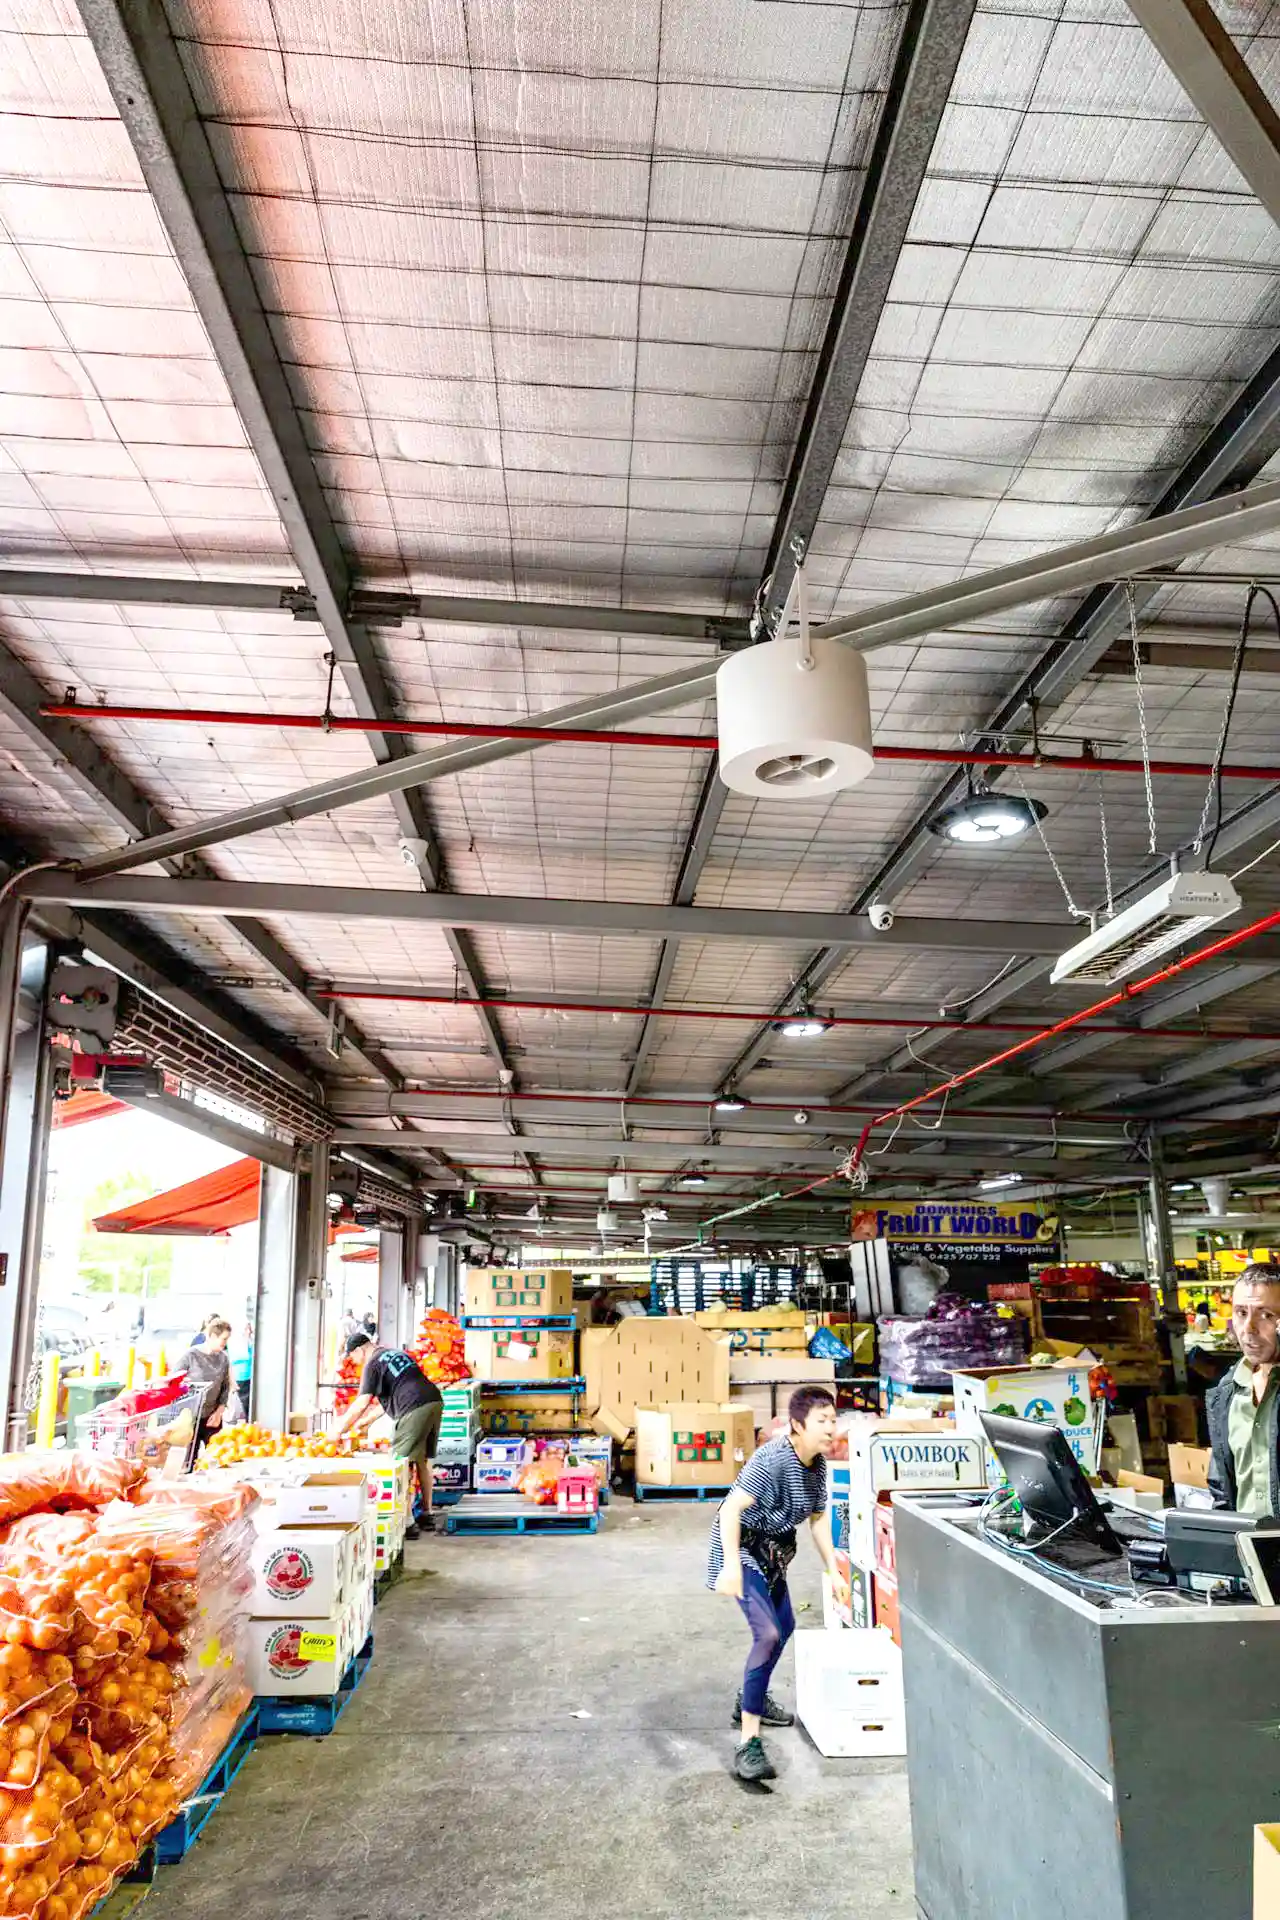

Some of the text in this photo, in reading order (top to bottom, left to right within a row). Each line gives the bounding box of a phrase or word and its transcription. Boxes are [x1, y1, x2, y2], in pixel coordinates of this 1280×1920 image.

[915, 1205, 998, 1215] DOMENICS
[876, 1210, 1038, 1240] FRUIT WORLD
[893, 1243, 1055, 1255] Fruit & Vegetable Supplies
[1064, 1427, 1093, 1437] DUCE
[881, 1445, 971, 1463] WOMBOK
